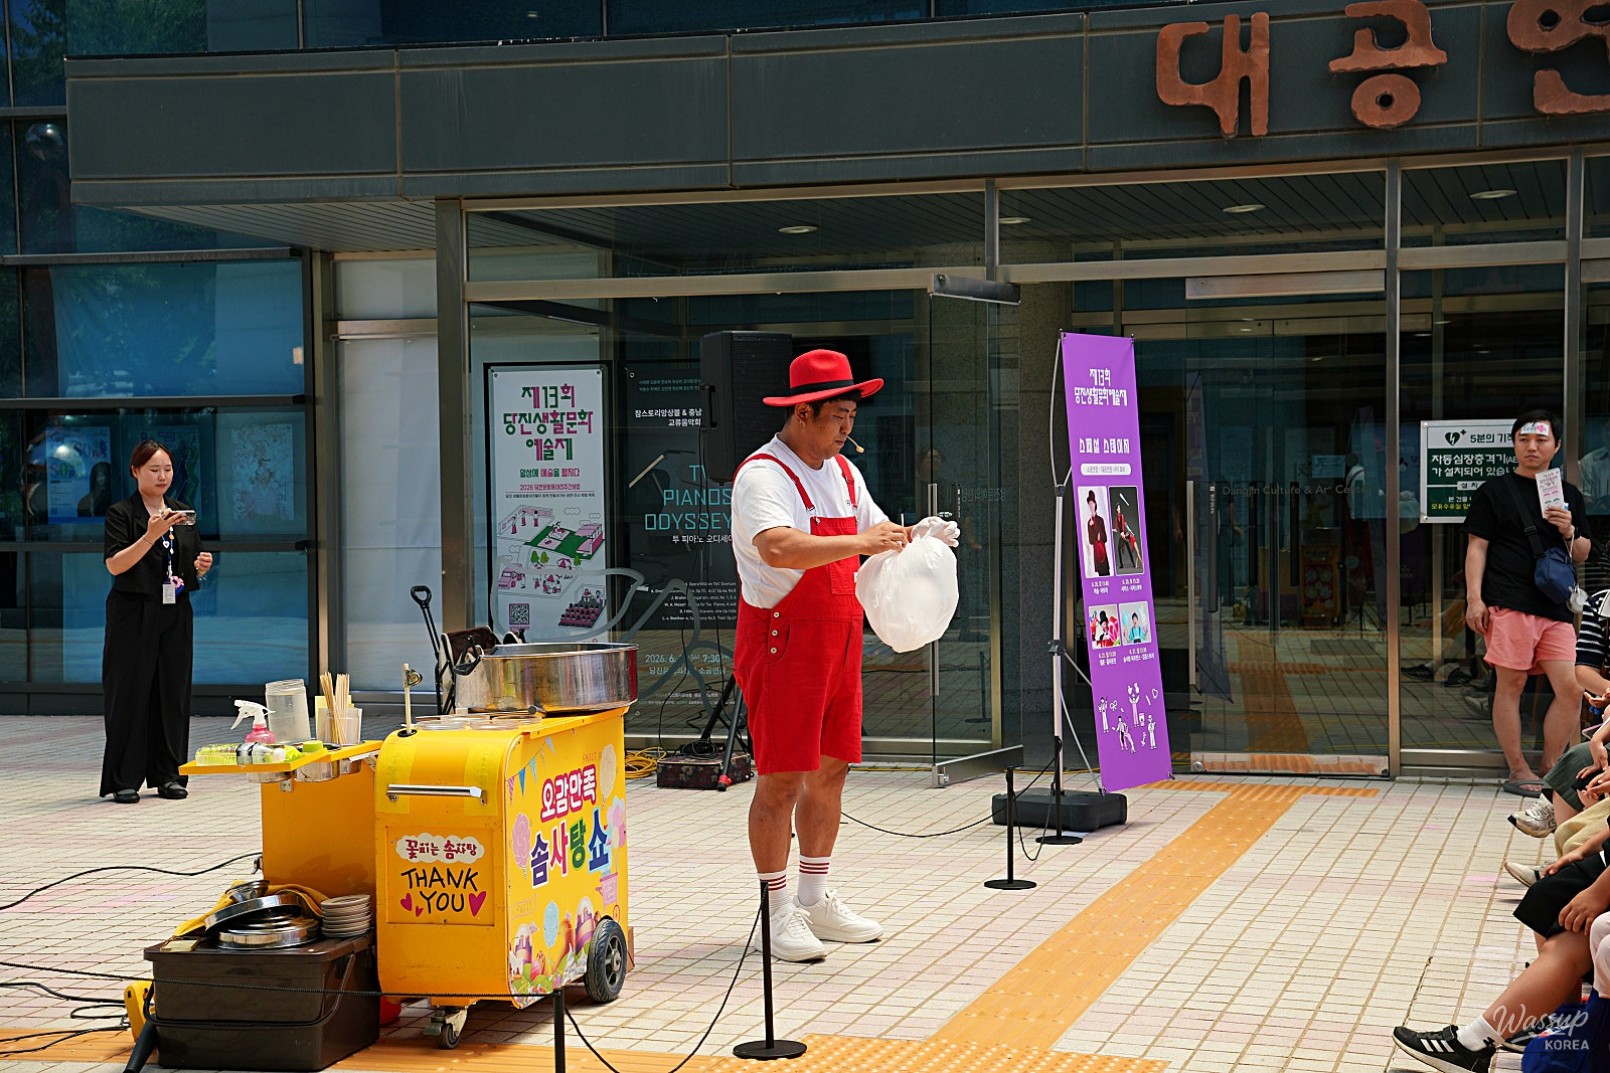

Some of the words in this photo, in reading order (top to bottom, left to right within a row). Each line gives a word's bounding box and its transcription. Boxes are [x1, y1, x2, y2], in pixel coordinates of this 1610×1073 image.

[1089, 368, 1110, 386] 제13회
[521, 383, 575, 409] 제13회
[1074, 386, 1128, 407] 당진생활문화예술제
[503, 409, 593, 435] 당진생활문화
[1079, 437, 1100, 454] 스페셜
[1103, 438, 1130, 454] 스테이지
[1470, 432, 1495, 443] 5분의
[526, 438, 573, 461] 예술제
[540, 468, 559, 478] 예술을
[1431, 468, 1442, 478] 가
[1444, 467, 1483, 477] 설치되어
[1304, 484, 1313, 494] &
[645, 513, 733, 530] ODYSSEY
[672, 535, 680, 544] 투
[645, 654, 667, 663] 2026.
[540, 763, 597, 823] 오감만족
[405, 839, 440, 859] 꽃피는
[443, 840, 478, 859] 솜사탕
[400, 866, 479, 892] THANK
[419, 891, 465, 914] YOU
